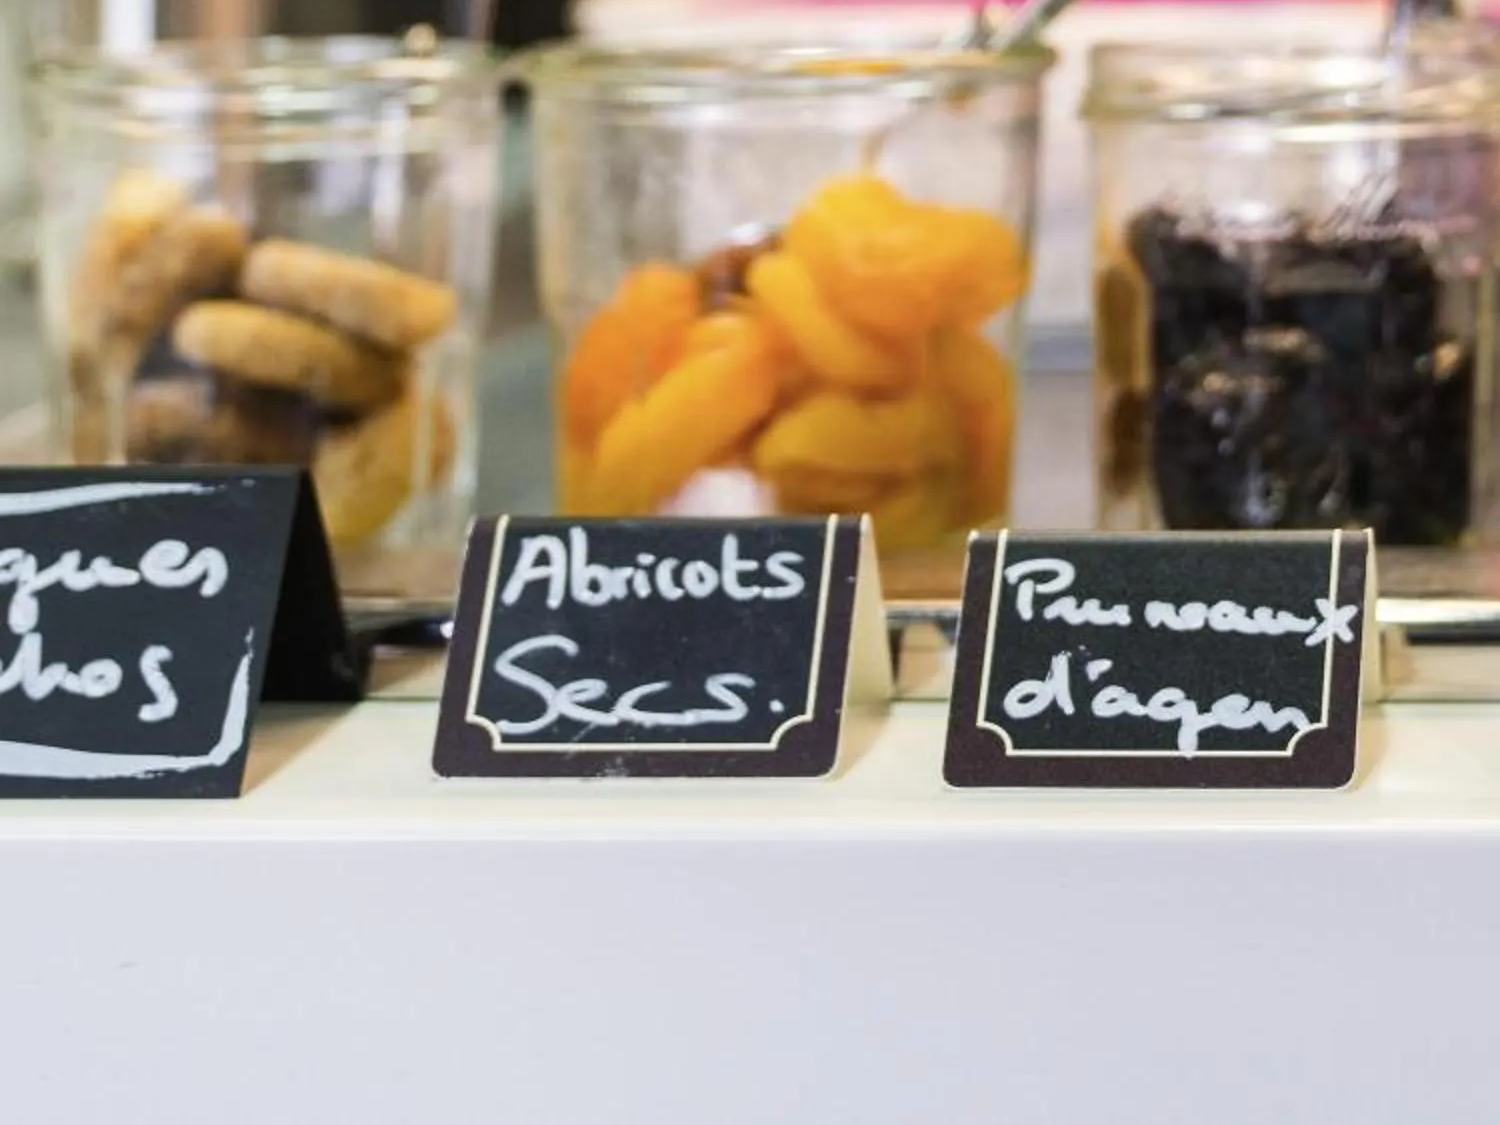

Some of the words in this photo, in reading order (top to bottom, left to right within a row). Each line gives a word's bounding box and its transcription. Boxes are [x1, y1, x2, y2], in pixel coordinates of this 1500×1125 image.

[501, 526, 805, 610] Abricots
[0, 632, 179, 723] hos
[494, 634, 785, 734] Secs.
